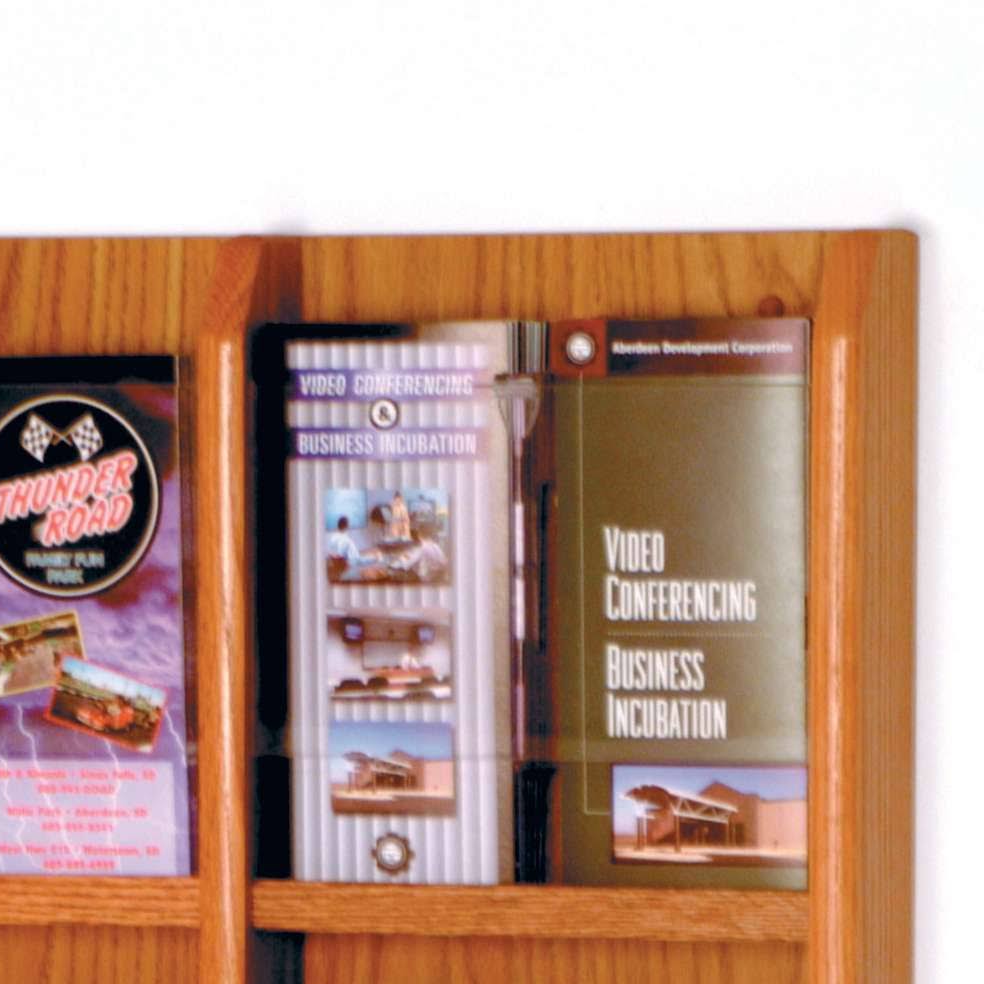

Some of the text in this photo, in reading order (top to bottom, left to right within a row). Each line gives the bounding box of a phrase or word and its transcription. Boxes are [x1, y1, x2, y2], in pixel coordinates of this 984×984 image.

[299, 374, 473, 396] VIDEO CONFERENCING
[378, 406, 391, 421] &
[298, 433, 476, 455] BUSINESS INCUBATION
[41, 494, 133, 547] ROAD
